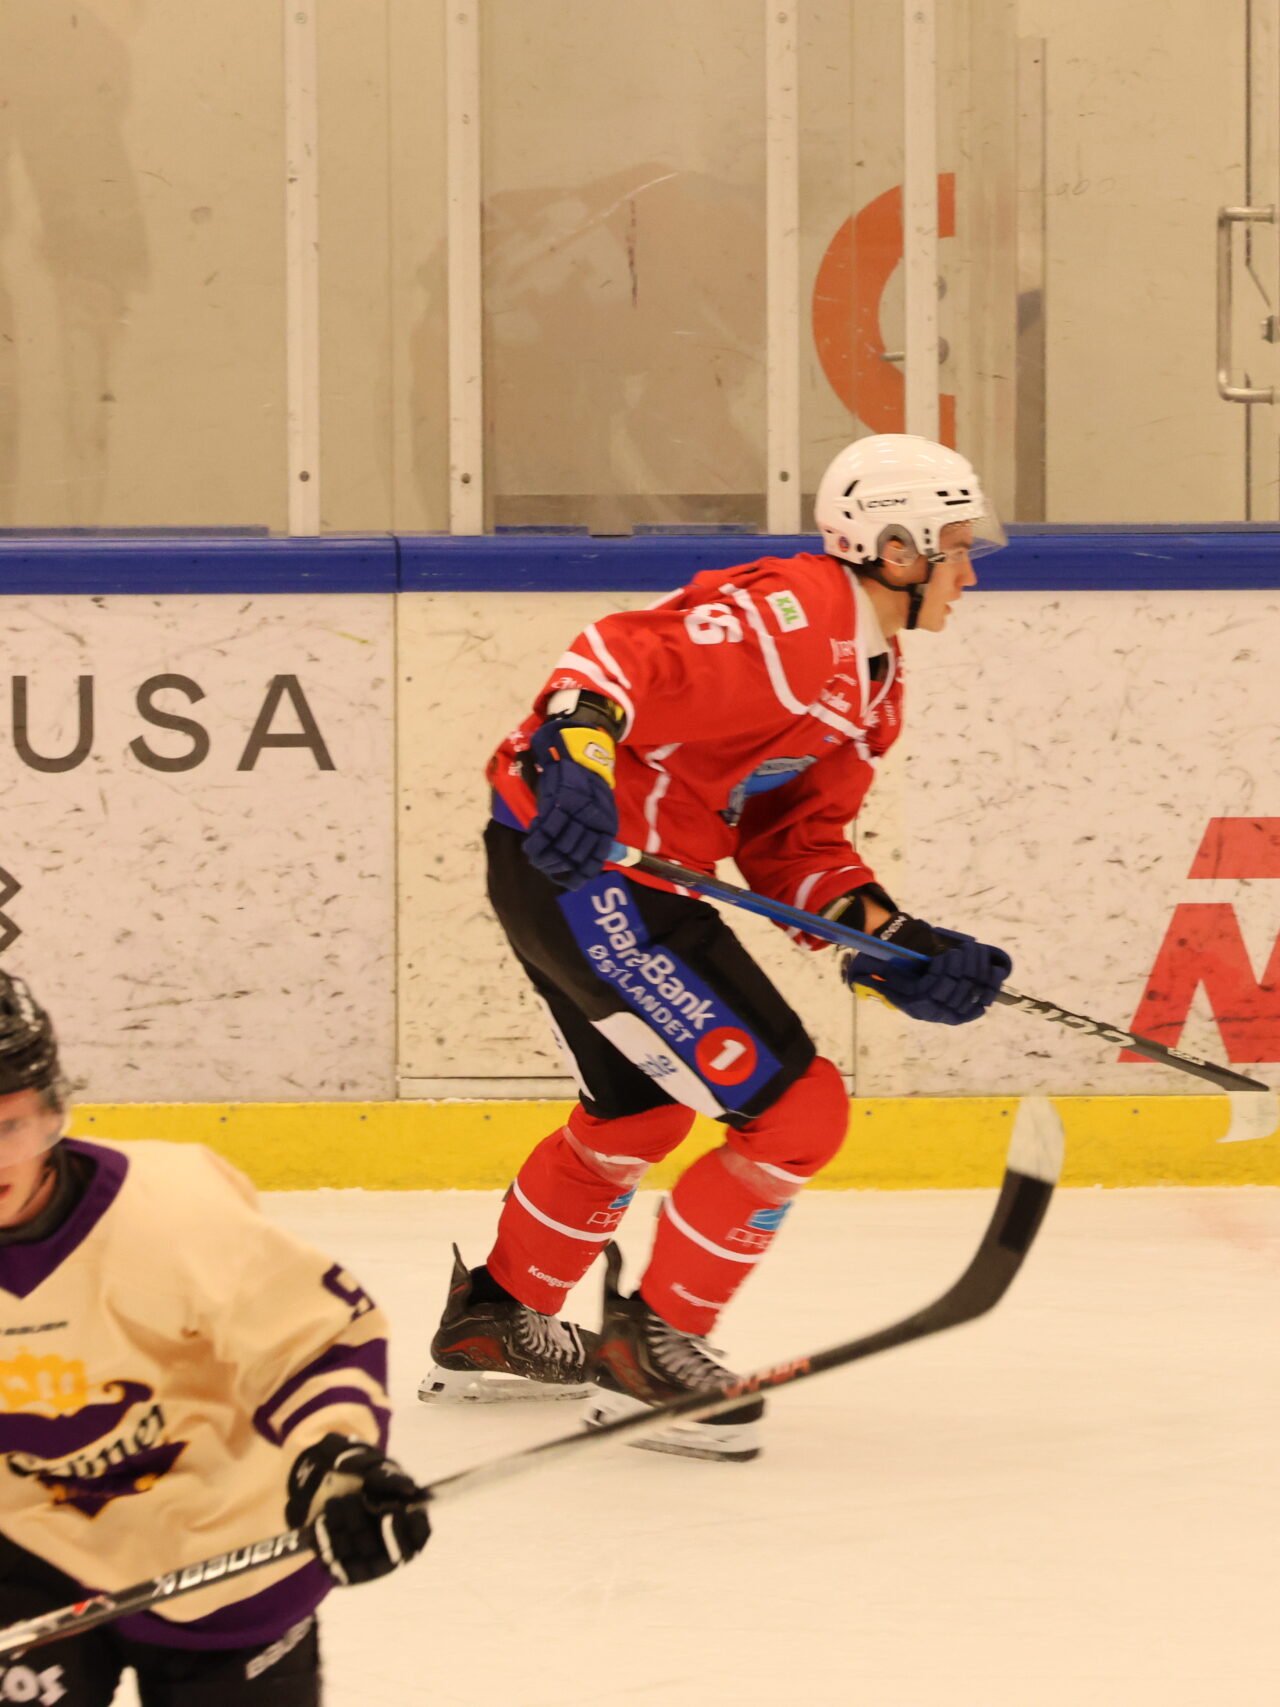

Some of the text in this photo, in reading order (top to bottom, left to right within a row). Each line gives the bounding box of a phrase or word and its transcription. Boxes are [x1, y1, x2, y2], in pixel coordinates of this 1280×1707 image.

[12, 674, 336, 773] USA
[709, 1039, 747, 1070] 1
[178, 1532, 299, 1590] BAUER
